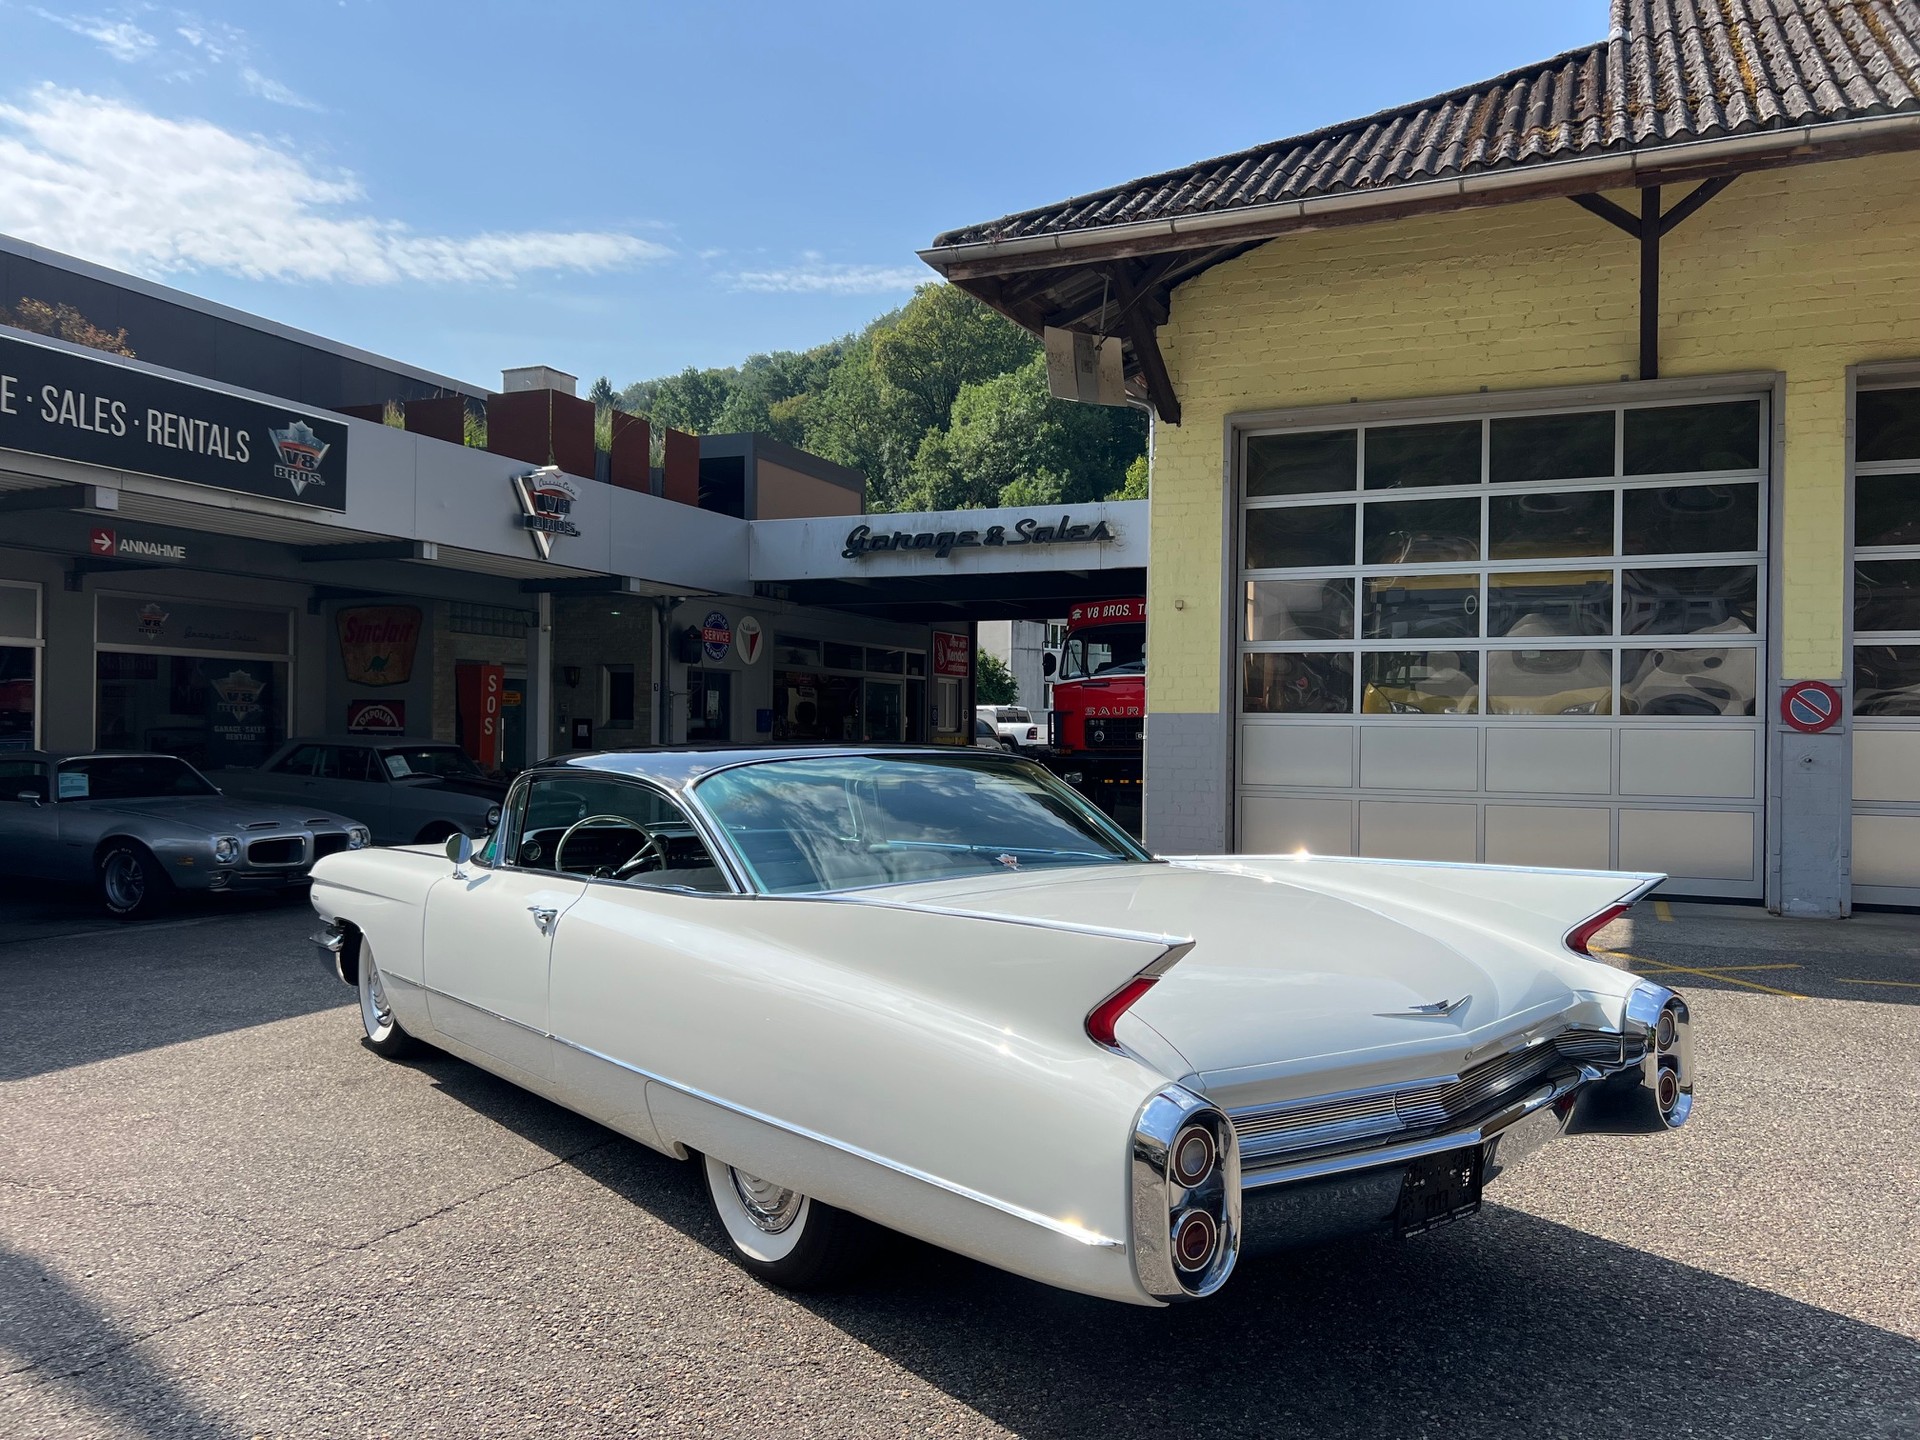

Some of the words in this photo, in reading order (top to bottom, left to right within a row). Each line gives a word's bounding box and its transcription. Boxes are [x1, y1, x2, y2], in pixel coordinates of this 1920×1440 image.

[40, 384, 127, 437] SALES
[146, 408, 251, 464] RENTALS
[284, 448, 317, 470] V8
[273, 464, 326, 487] BROS.
[841, 524, 981, 558] Garage
[983, 525, 1007, 546] &
[1006, 515, 1116, 545] Sales
[119, 538, 187, 560] ANNAHME
[704, 613, 729, 631] CHRYSLER
[1086, 606, 1099, 619] V8
[1102, 604, 1132, 618] BROS.
[345, 616, 413, 642] Sinclair
[703, 630, 730, 644] SERVICE
[358, 709, 393, 726] DAPOLIN
